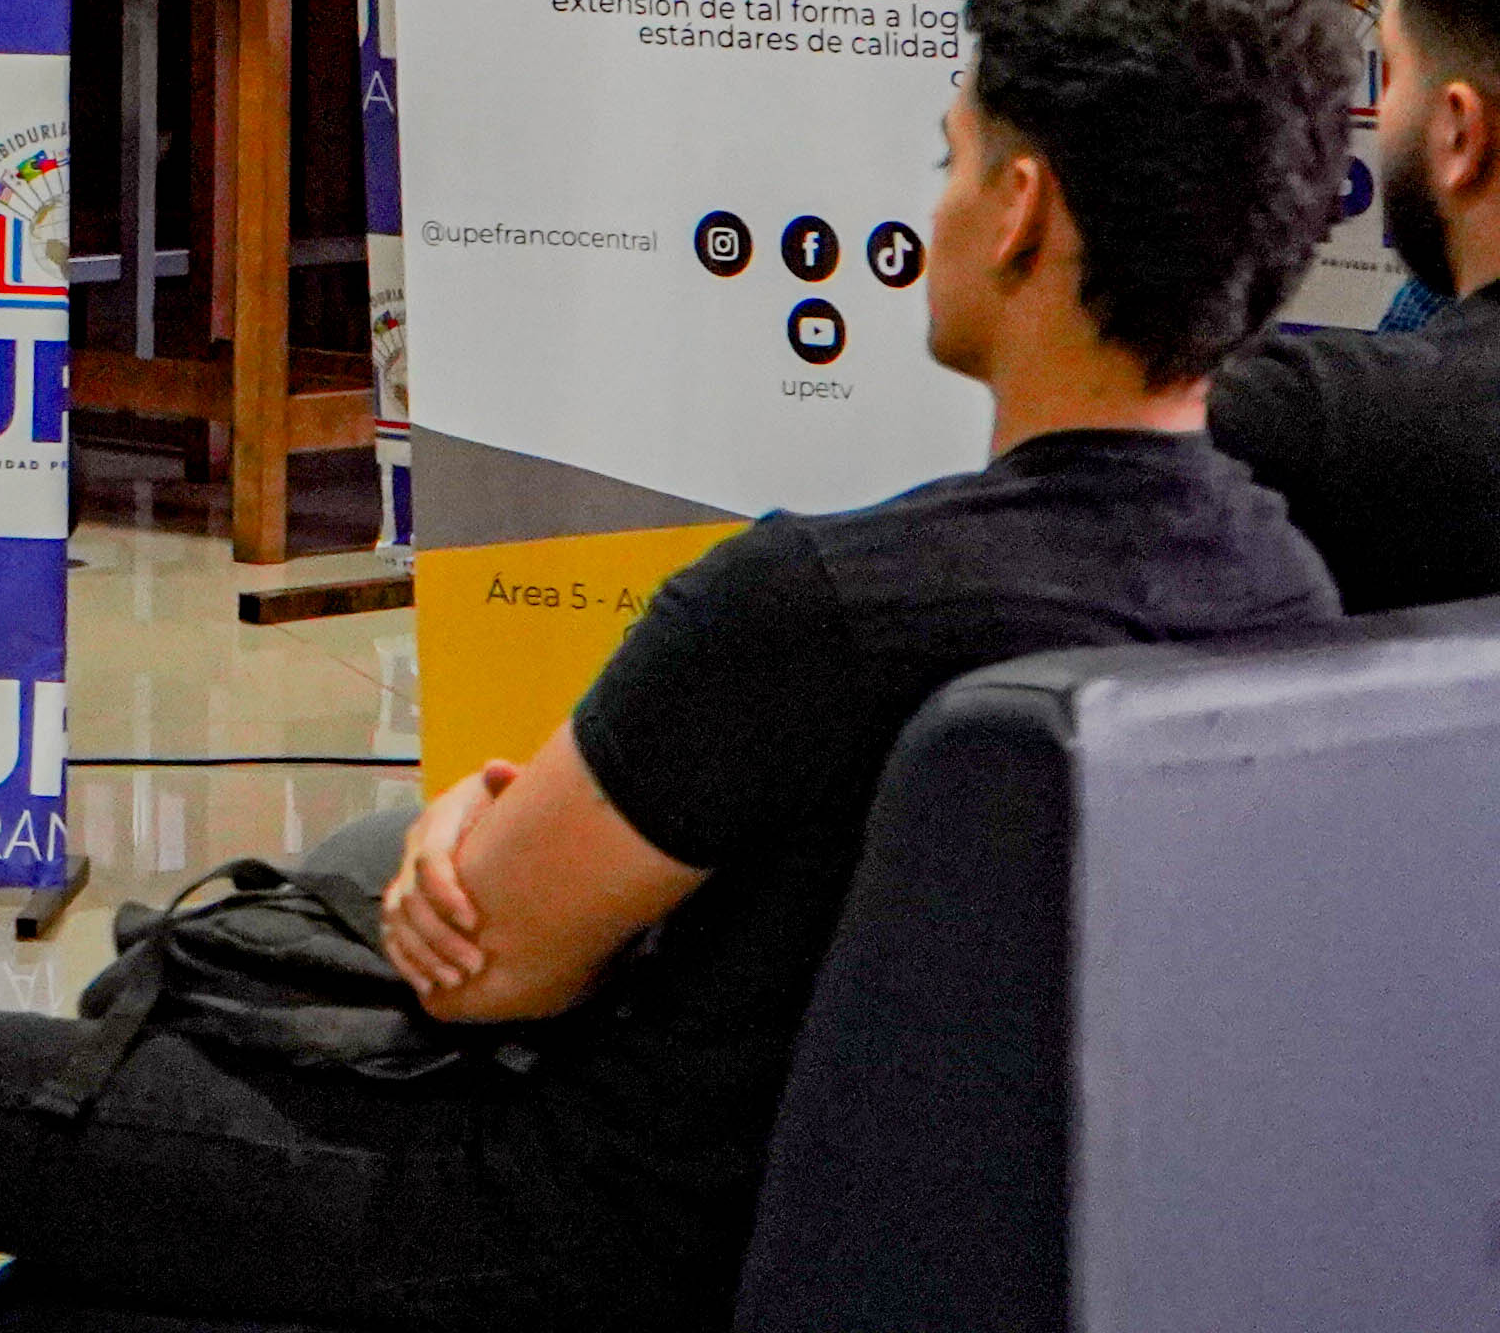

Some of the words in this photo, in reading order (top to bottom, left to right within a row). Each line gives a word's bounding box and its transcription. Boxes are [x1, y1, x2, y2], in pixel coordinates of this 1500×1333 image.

[886, 9, 900, 27] a
[912, 3, 959, 35] log
[639, 24, 799, 51] estándares
[807, 28, 842, 53] de
[852, 31, 959, 59] calidad
[421, 220, 657, 252] @upefrancocentral
[781, 377, 853, 401] upetv
[486, 572, 560, 608] Área
[571, 583, 588, 610] 5
[615, 588, 650, 614] Av
